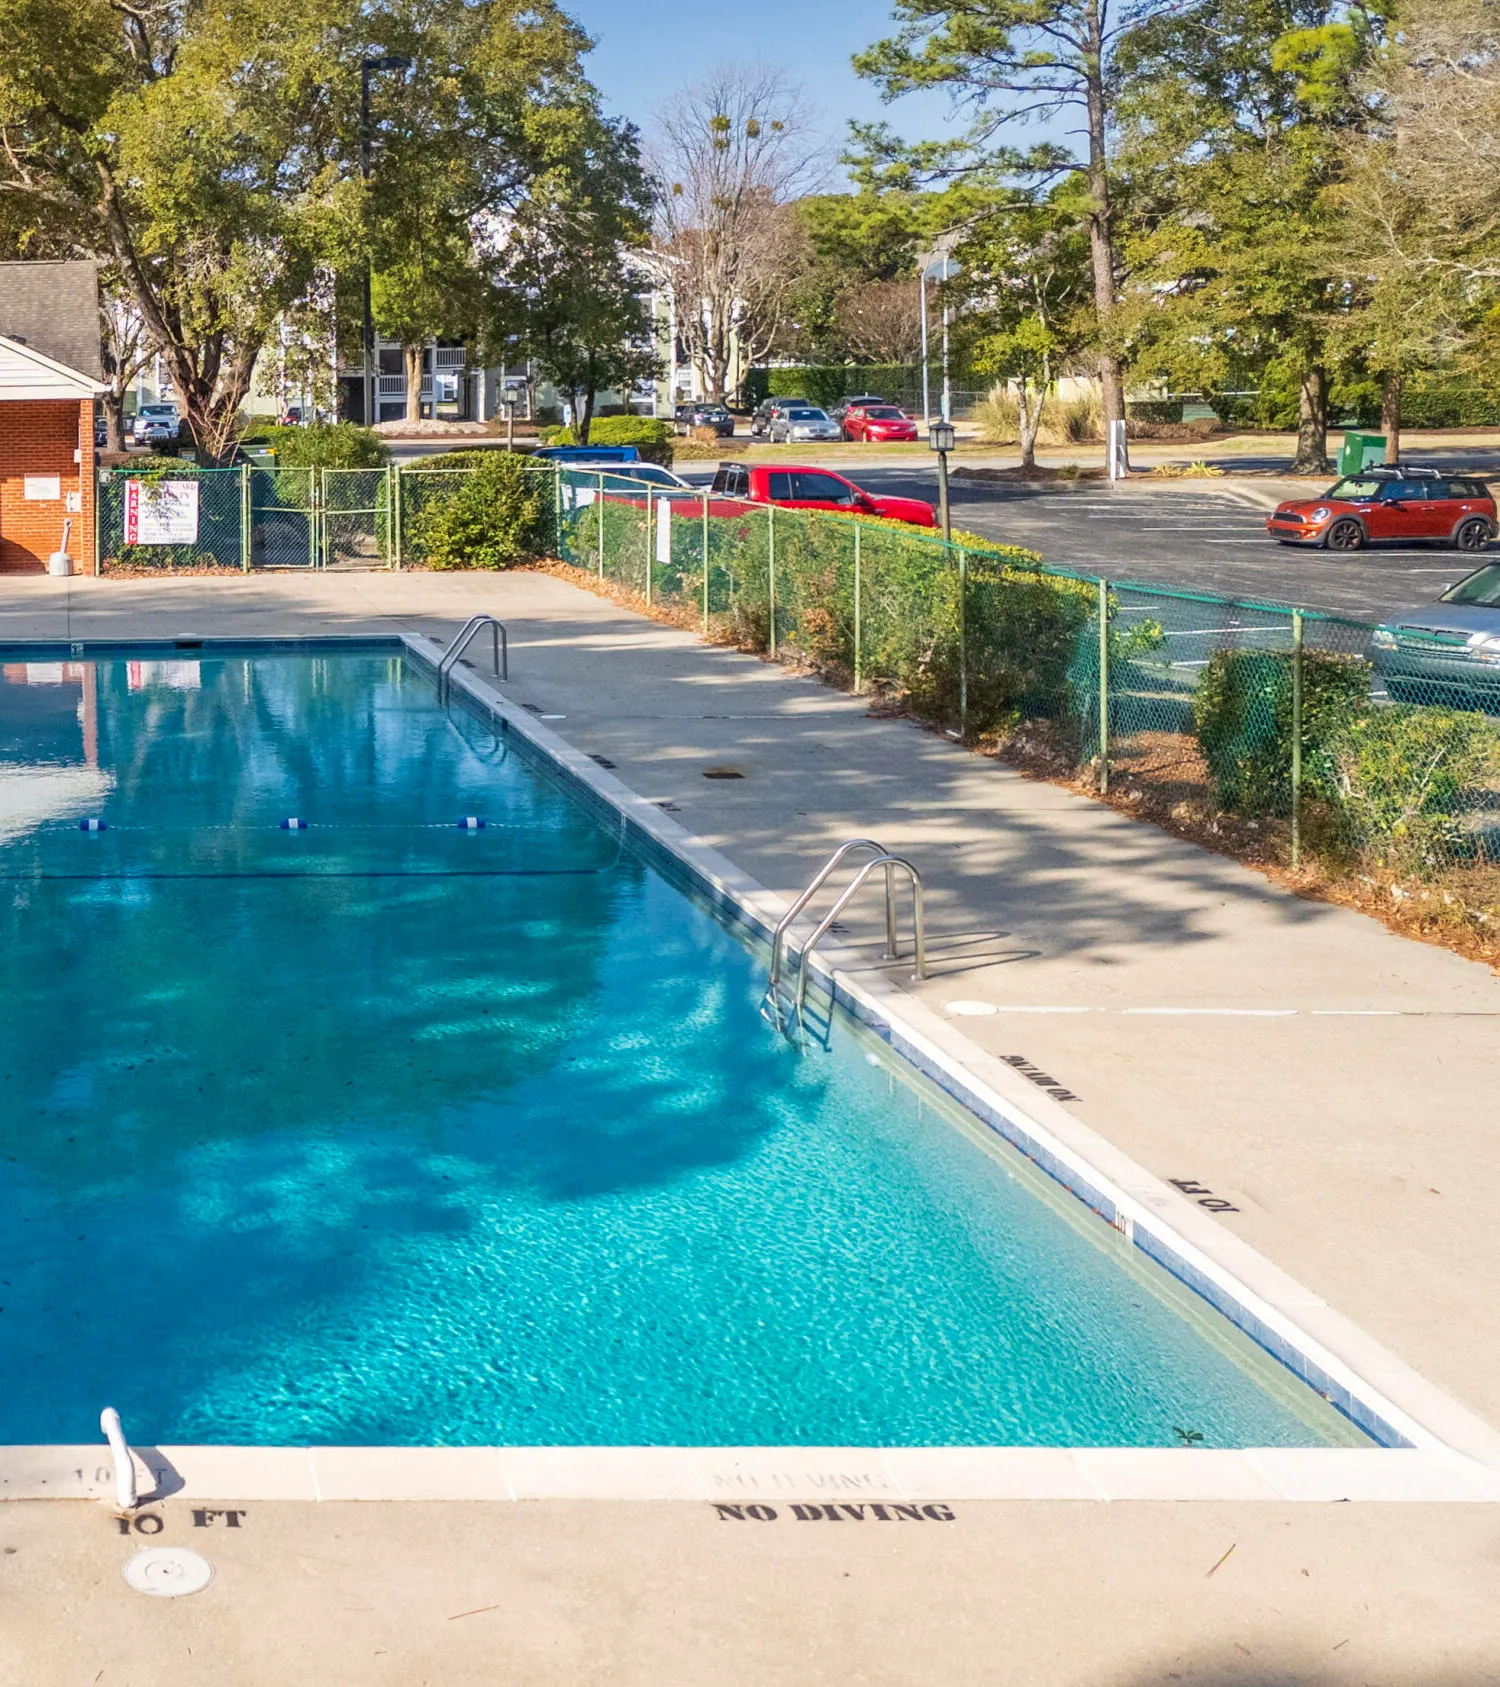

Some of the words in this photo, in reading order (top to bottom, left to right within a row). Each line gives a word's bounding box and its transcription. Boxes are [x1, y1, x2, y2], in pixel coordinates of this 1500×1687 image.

[129, 483, 139, 541] WARNING
[770, 1471, 891, 1490] DVING
[115, 1513, 164, 1535] 10
[190, 1508, 247, 1528] FT
[710, 1503, 779, 1521] NO
[787, 1503, 957, 1522] DIVING
